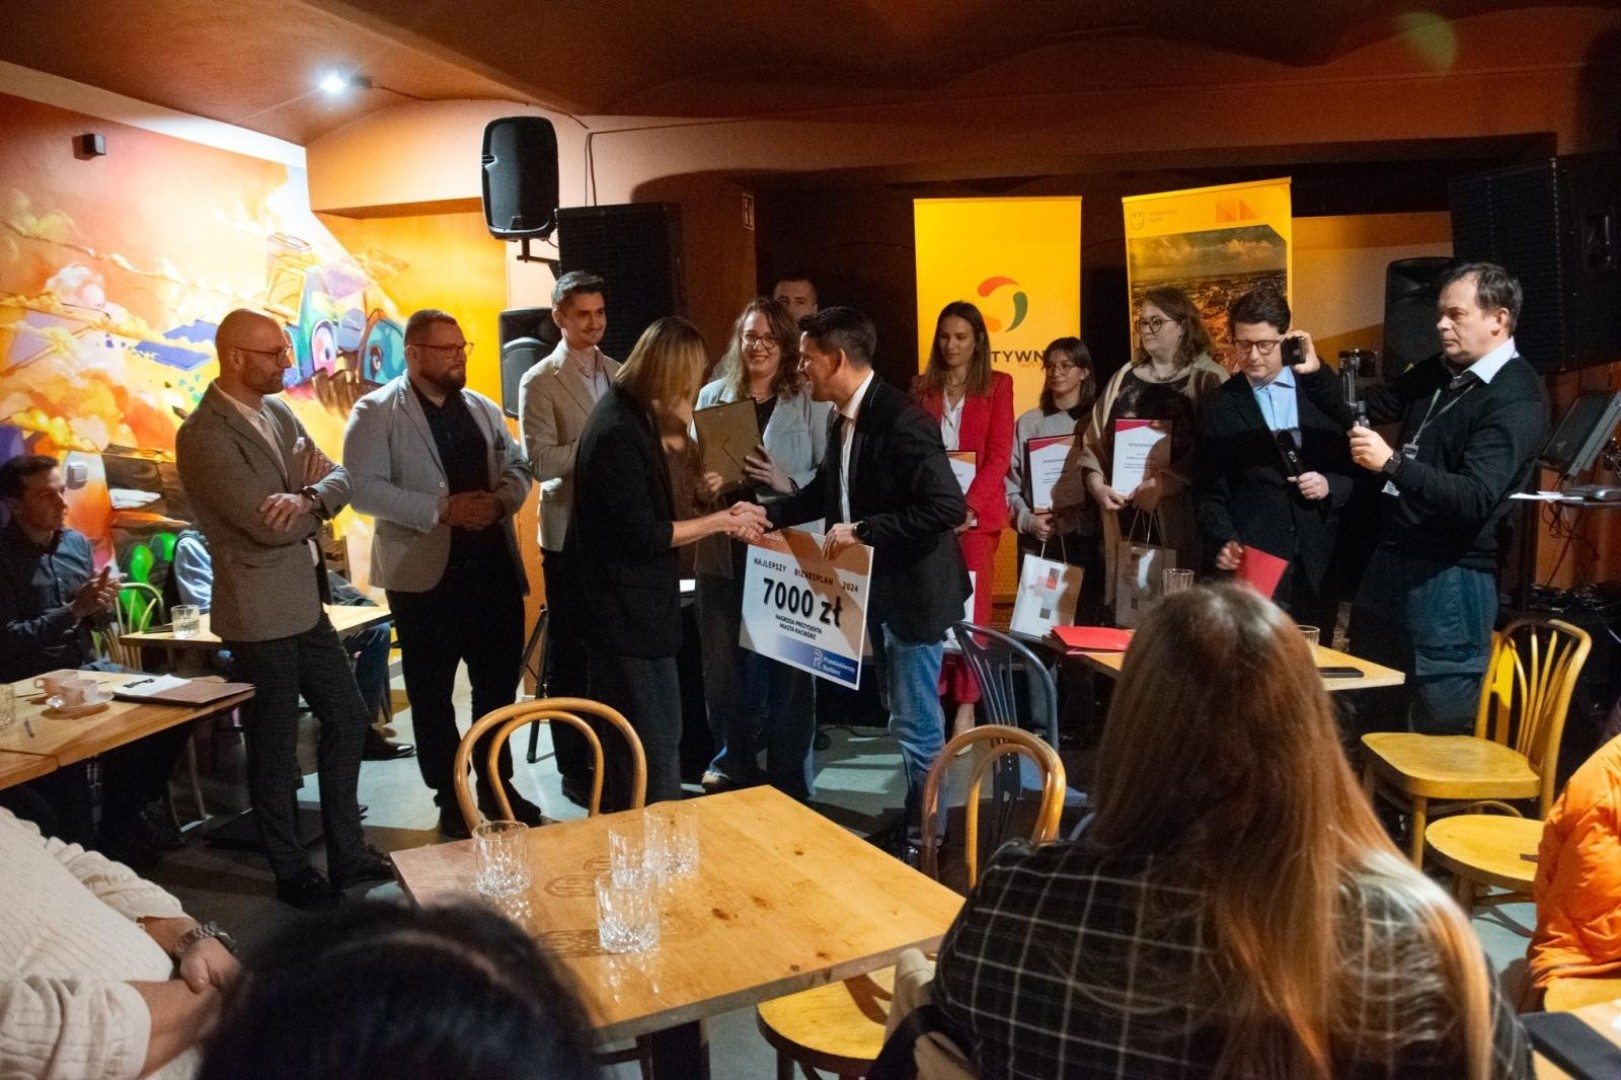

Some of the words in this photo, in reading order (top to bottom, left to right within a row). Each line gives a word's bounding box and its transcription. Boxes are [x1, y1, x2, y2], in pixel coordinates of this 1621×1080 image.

[991, 350, 1045, 363] TYWN
[753, 557, 787, 573] NAJLEPSZY
[794, 568, 834, 586] BIZNESPLAN
[842, 581, 859, 592] 2024
[763, 577, 814, 618] 7000
[819, 595, 843, 628] zł
